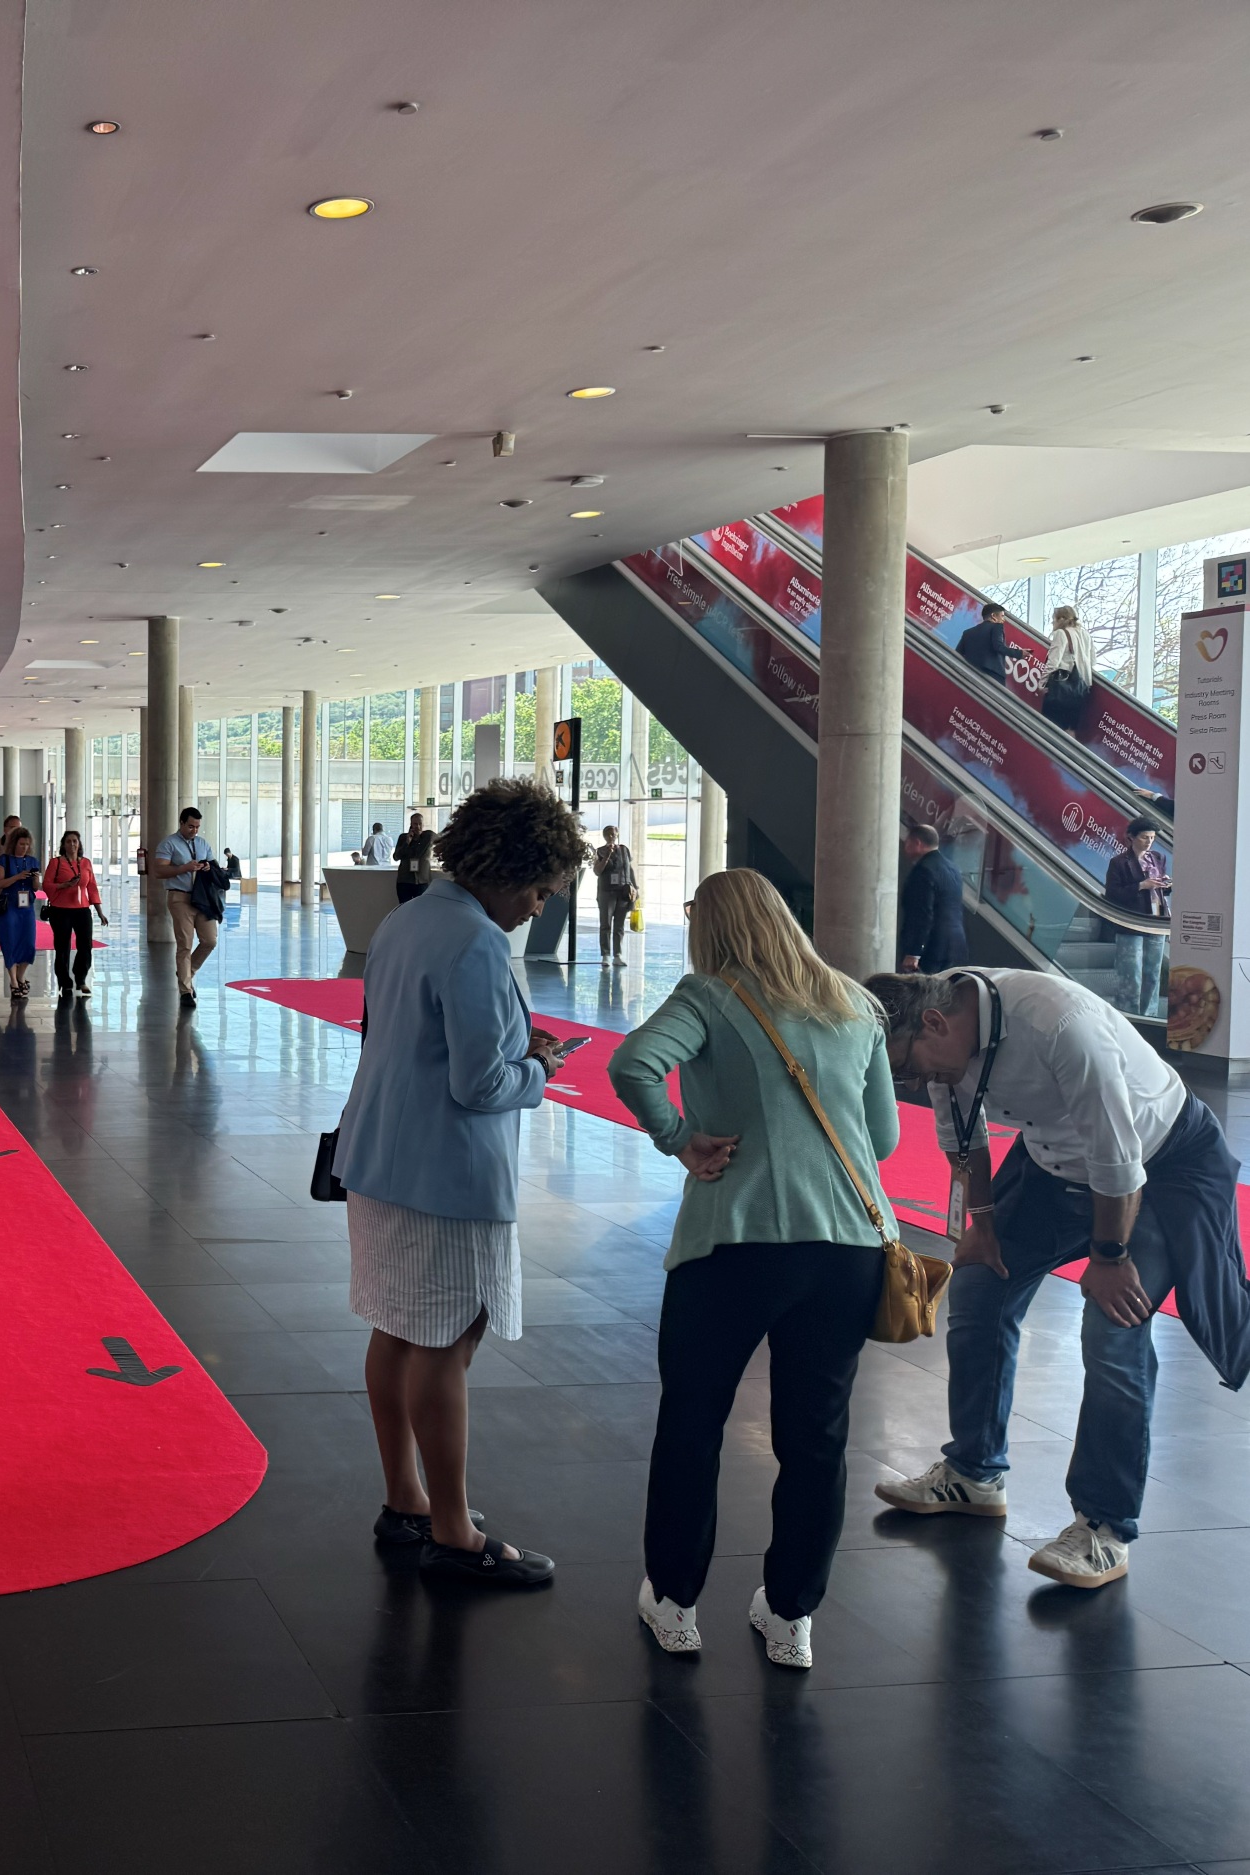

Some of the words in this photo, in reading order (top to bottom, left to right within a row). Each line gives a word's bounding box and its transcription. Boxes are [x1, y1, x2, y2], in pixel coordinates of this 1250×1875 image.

[666, 567, 682, 589] Free
[682, 583, 706, 610] simple
[790, 576, 820, 606] Albuminuria
[920, 581, 955, 612] Albuminuria
[767, 656, 797, 689] Follow
[796, 682, 812, 705] the
[1210, 689, 1235, 697] Meeting
[1190, 713, 1208, 721] Press
[1208, 712, 1227, 720] Room
[1198, 699, 1220, 707] Rooms
[948, 715, 978, 742] Boehringer
[976, 738, 1004, 765] Ingelheim
[952, 706, 966, 721] Free
[964, 717, 981, 733] uACR
[979, 728, 992, 742] test
[990, 738, 998, 747] at
[997, 742, 1008, 755] the
[952, 730, 969, 748] booth
[967, 744, 976, 754] on
[975, 749, 990, 765] level
[1098, 720, 1130, 748] Boehringer
[1129, 743, 1160, 770] Ingelheim
[1102, 711, 1117, 726] Free
[1115, 722, 1134, 738] uACR
[1132, 733, 1146, 747] test
[1145, 743, 1153, 752] at
[1152, 747, 1164, 760] the
[1102, 734, 1120, 754] booth
[1119, 749, 1128, 760] on
[1127, 753, 1144, 770] level
[1086, 815, 1128, 855] Boehringe
